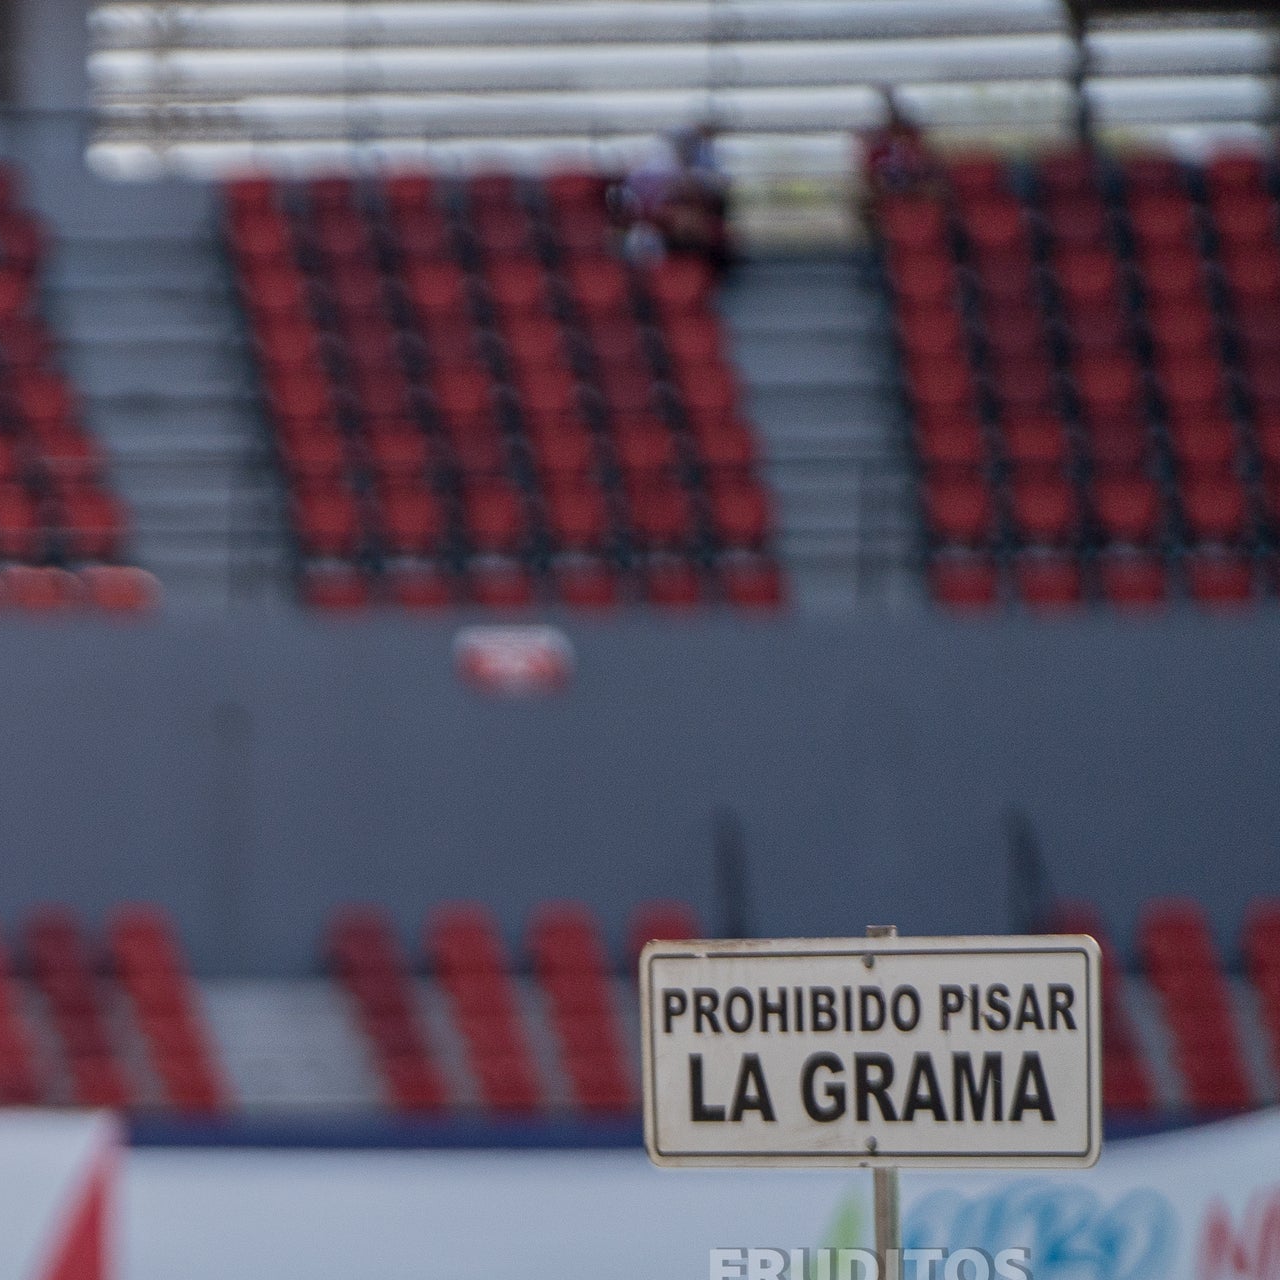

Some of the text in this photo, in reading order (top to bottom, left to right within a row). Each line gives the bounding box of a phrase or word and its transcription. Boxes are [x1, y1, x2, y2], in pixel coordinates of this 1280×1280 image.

[662, 983, 1078, 1033] PROHIBIDO PISAR
[689, 1050, 1056, 1123] LA GRAMA
